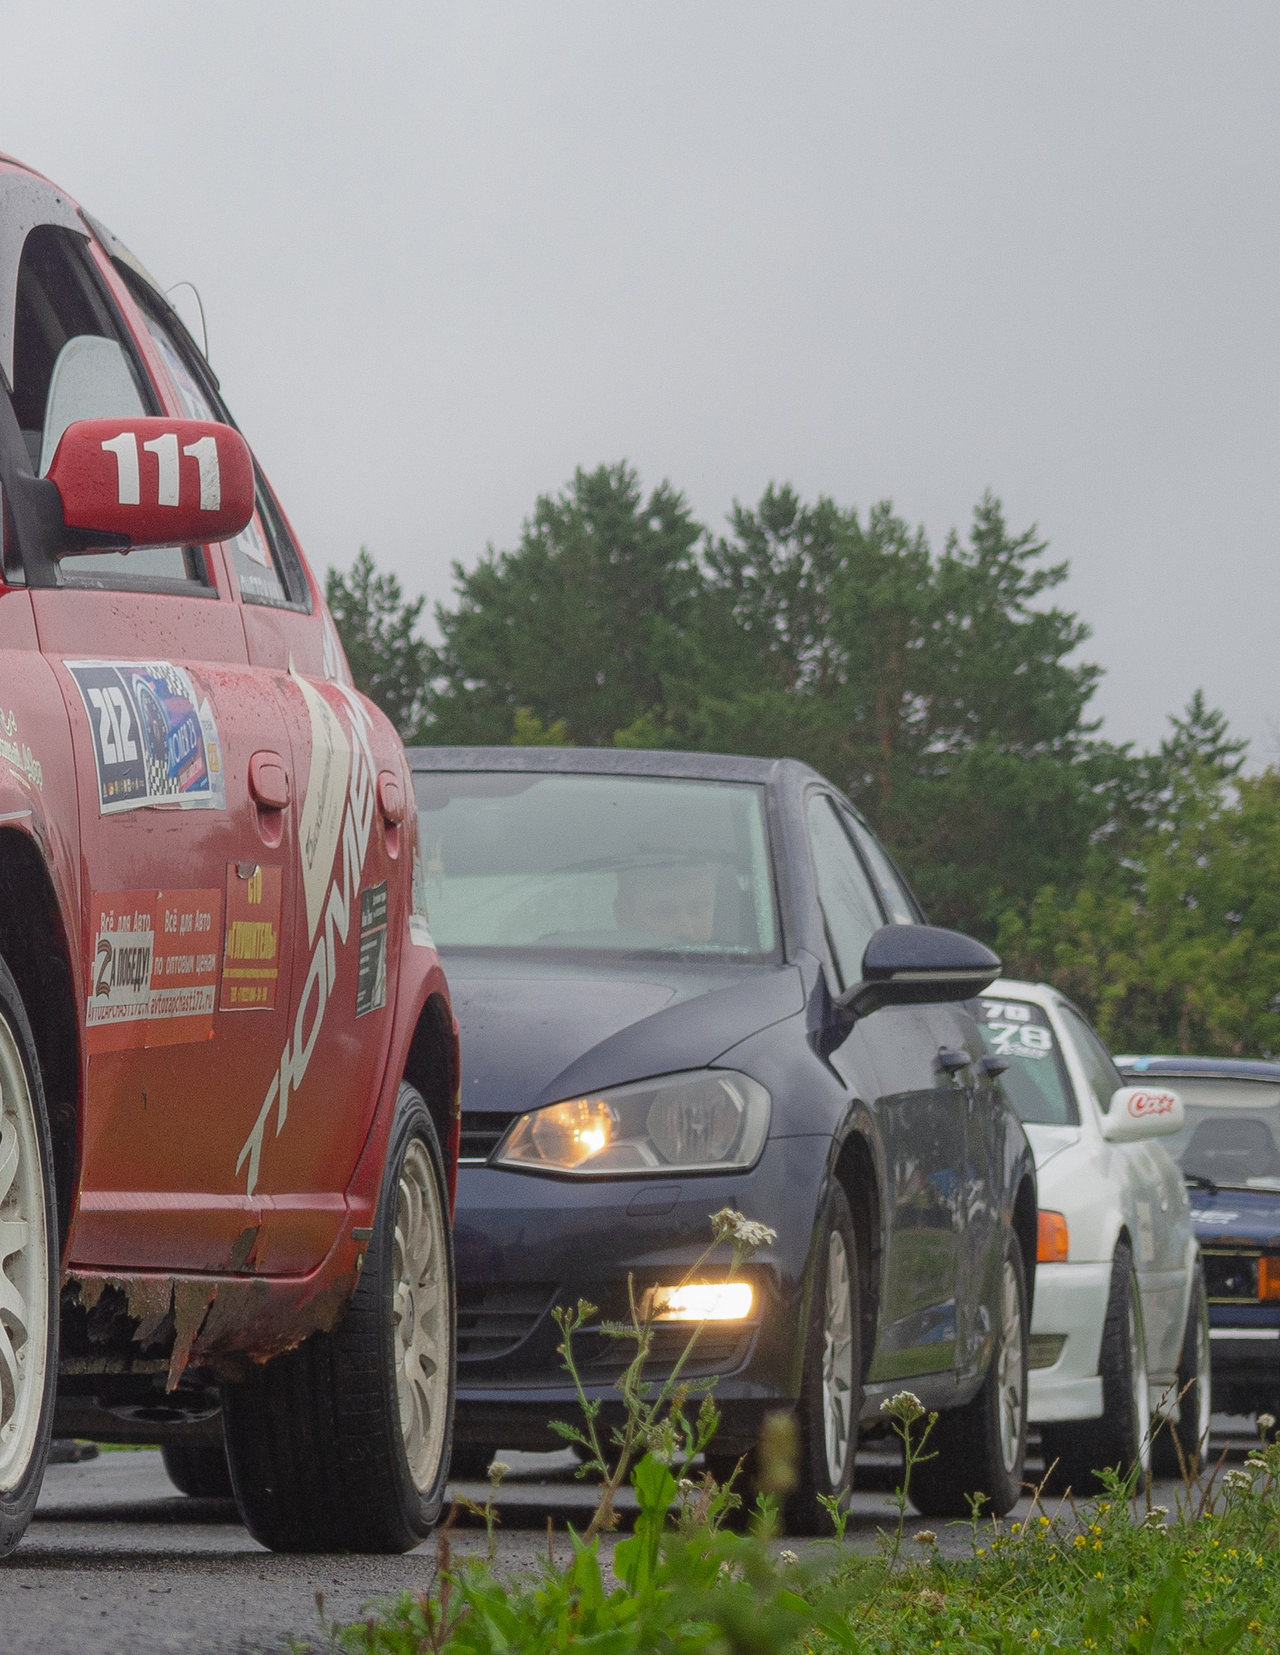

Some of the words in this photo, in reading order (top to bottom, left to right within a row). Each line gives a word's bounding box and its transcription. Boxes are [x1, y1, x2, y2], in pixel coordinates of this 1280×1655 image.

[101, 432, 221, 511] 111
[164, 908, 177, 933] Всё
[180, 913, 193, 936] для
[194, 909, 212, 932] Авто
[987, 1022, 1053, 1051] 78
